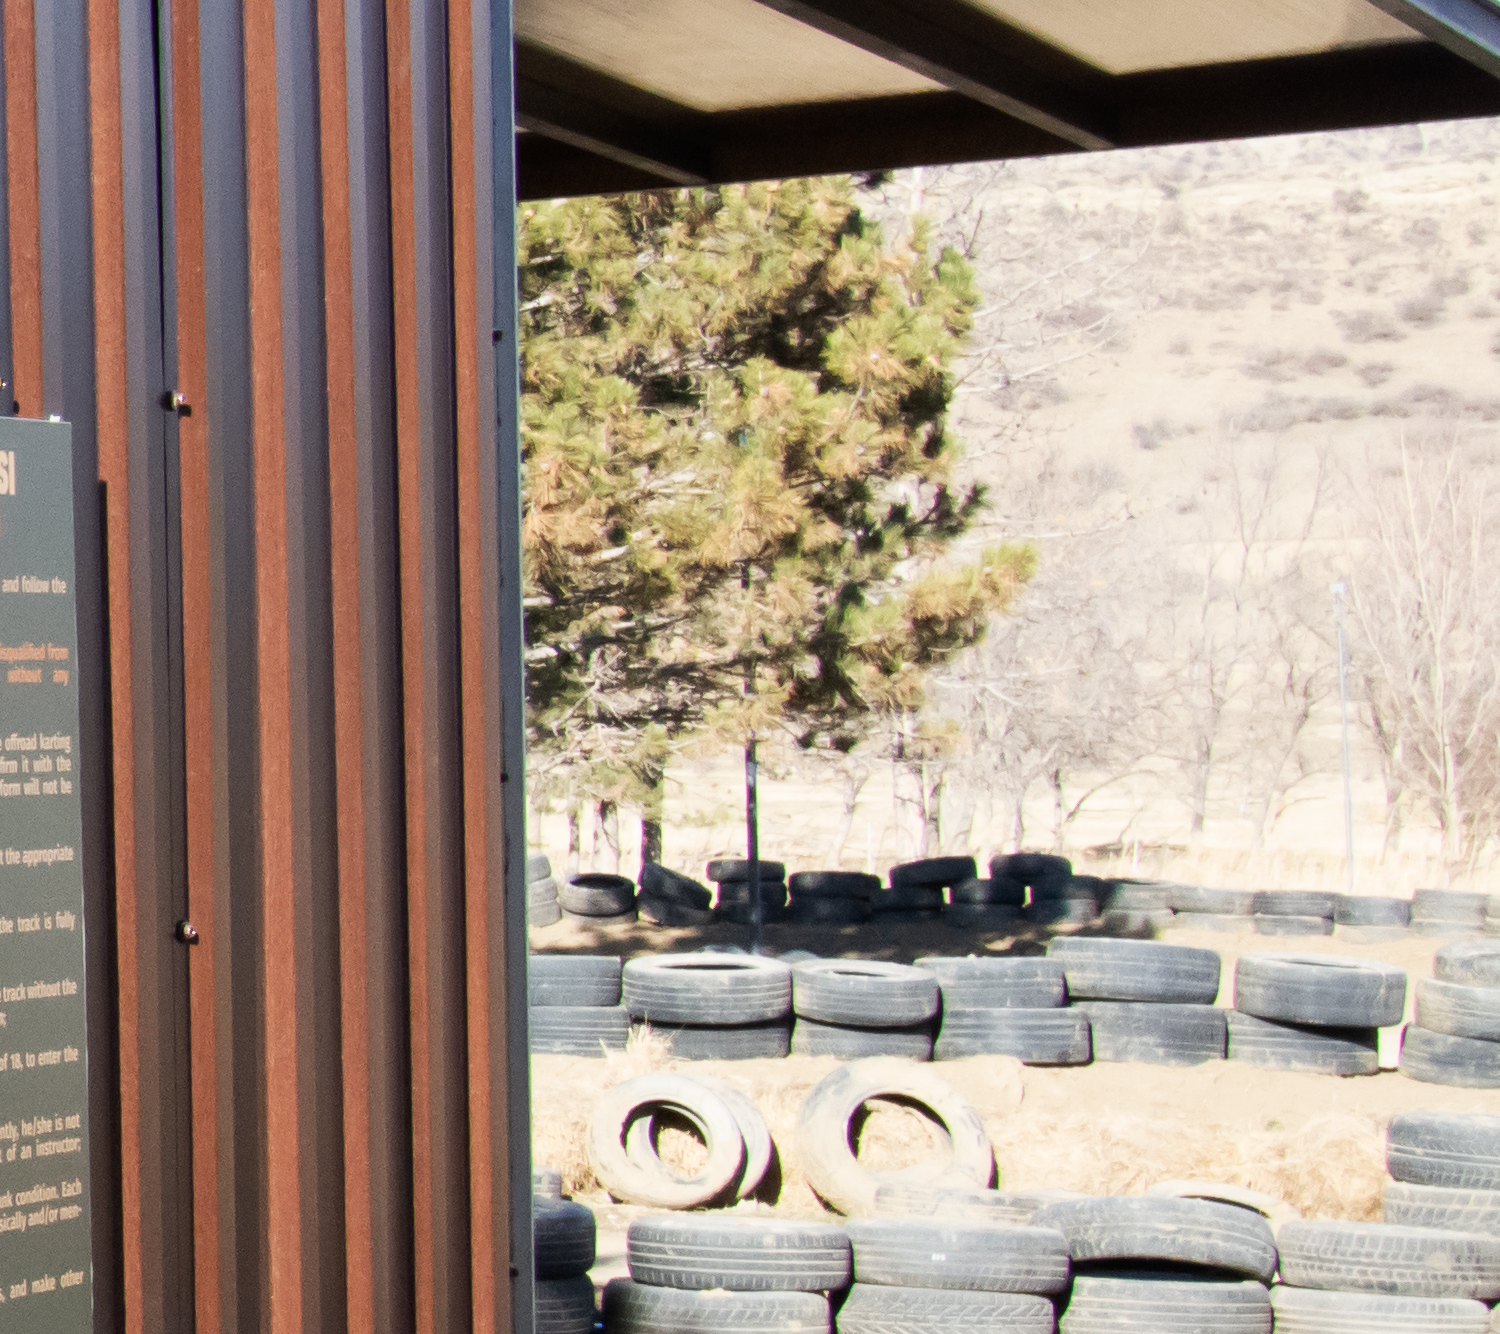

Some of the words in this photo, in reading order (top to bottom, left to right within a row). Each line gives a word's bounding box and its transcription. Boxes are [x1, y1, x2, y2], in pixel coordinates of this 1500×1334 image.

[1, 575, 20, 593] and
[20, 574, 50, 594] follow
[50, 575, 67, 595] the
[16, 912, 41, 933] track
[43, 911, 53, 930] is
[9, 1278, 27, 1300] and
[30, 1273, 56, 1294] make
